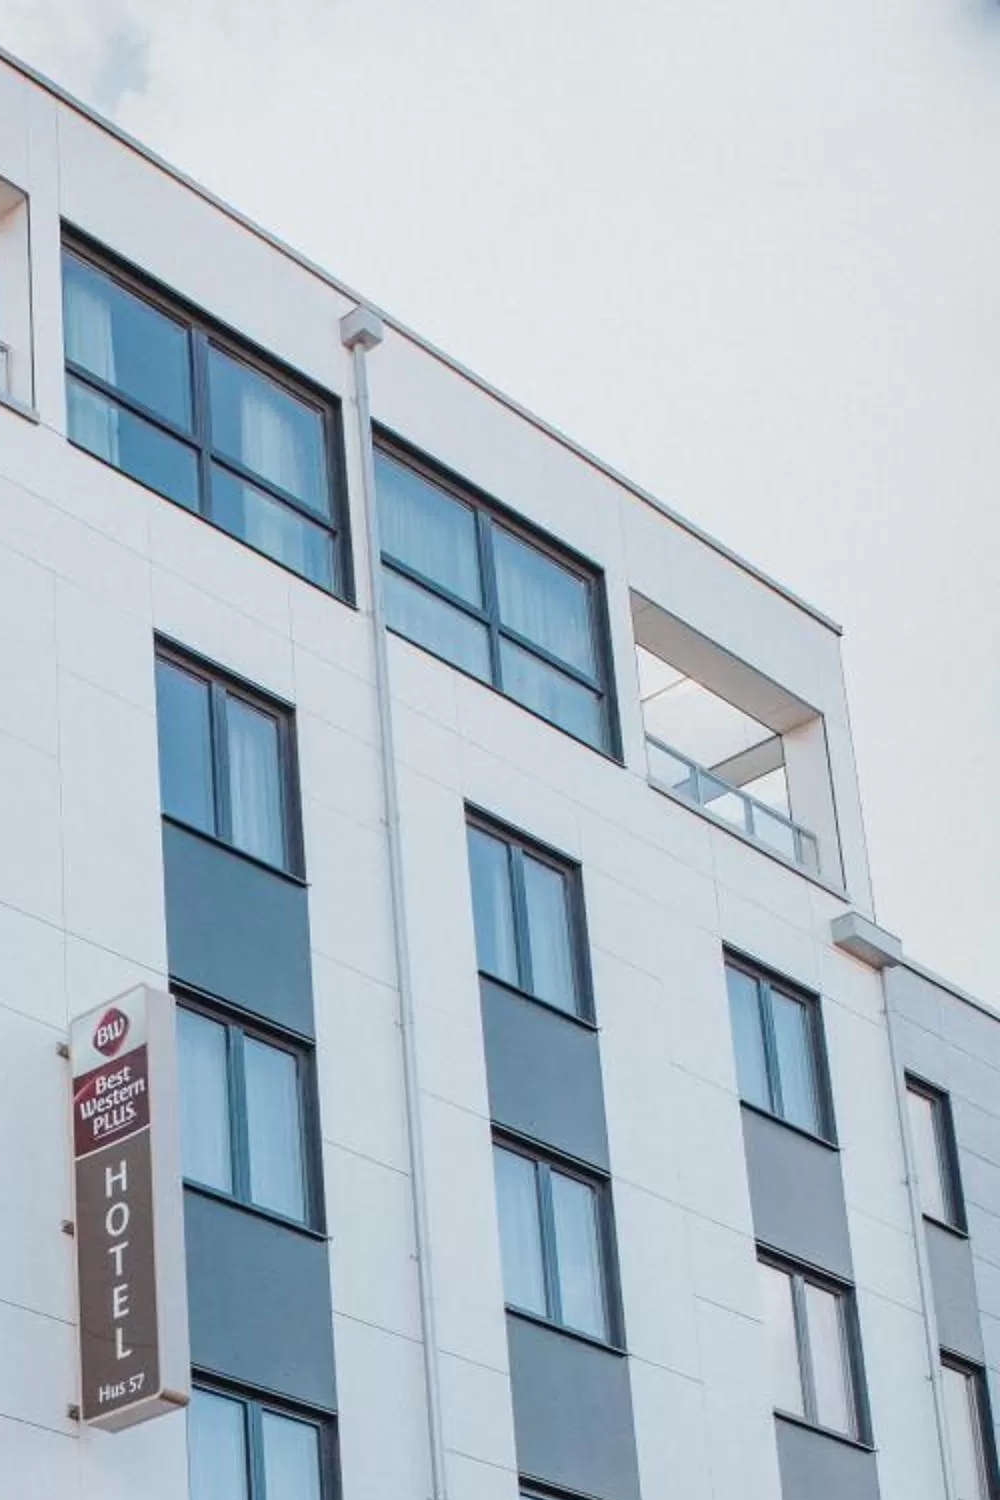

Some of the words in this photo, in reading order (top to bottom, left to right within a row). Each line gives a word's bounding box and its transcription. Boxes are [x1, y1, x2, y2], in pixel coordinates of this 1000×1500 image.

[95, 1066, 132, 1095] Best
[80, 1078, 145, 1121] Western
[93, 1101, 137, 1136] PLUS
[104, 1159, 132, 1361] HOTEL
[128, 1372, 145, 1393] 57
